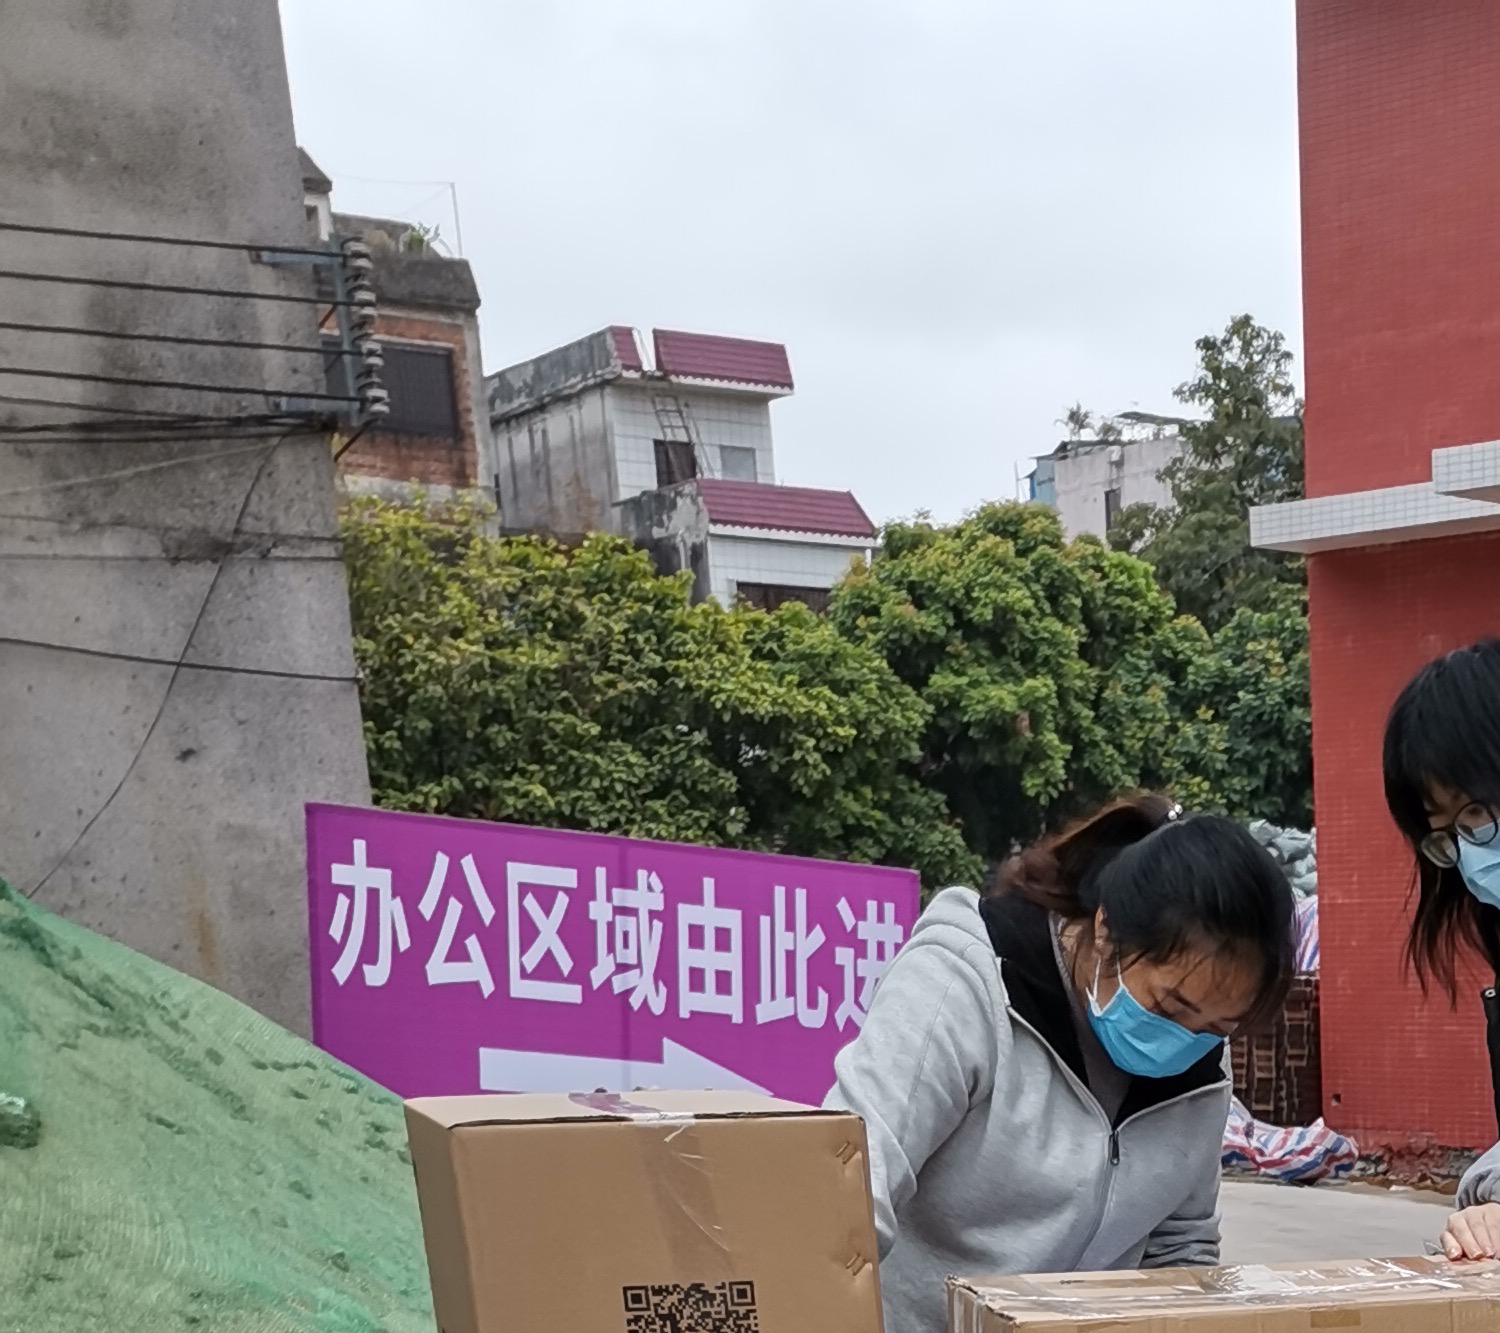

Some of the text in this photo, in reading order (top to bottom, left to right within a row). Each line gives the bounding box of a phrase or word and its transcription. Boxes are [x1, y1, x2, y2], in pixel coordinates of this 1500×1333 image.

[329, 839, 903, 1031] 办公区域由此进
